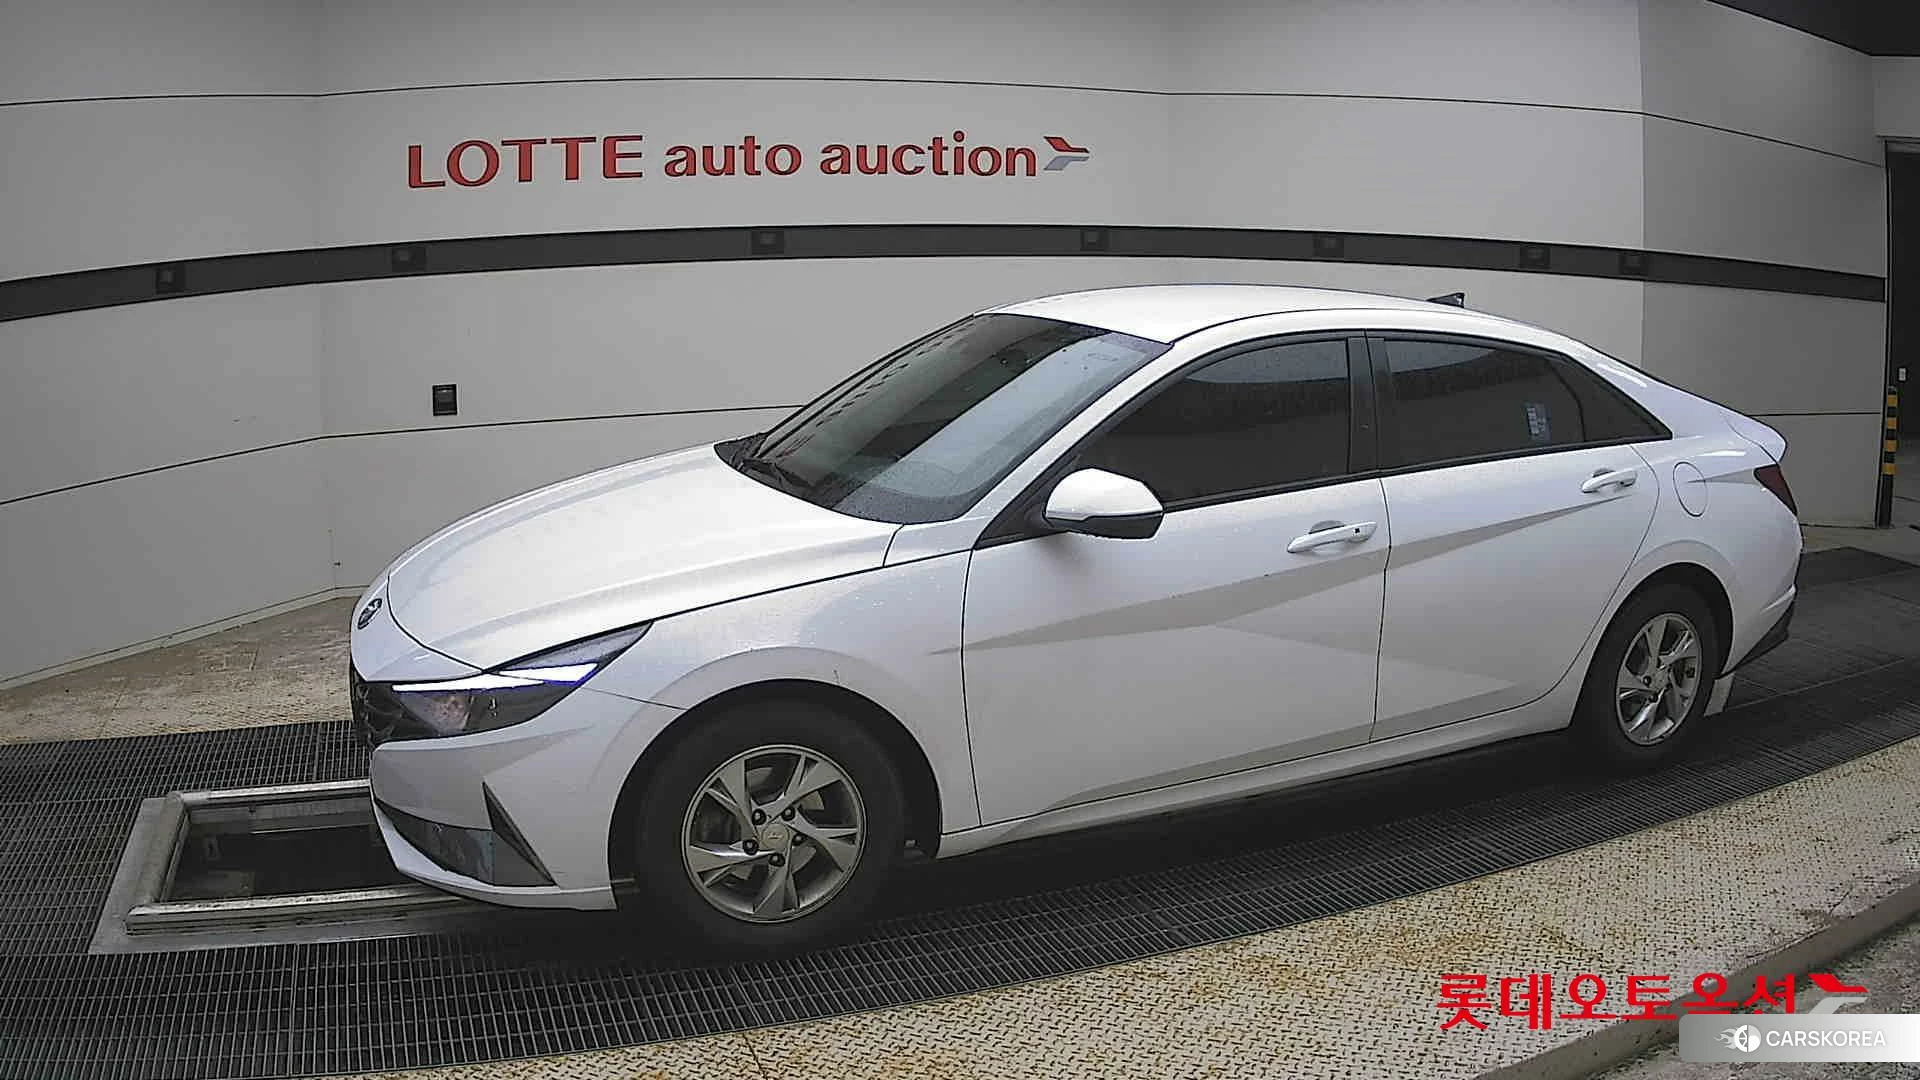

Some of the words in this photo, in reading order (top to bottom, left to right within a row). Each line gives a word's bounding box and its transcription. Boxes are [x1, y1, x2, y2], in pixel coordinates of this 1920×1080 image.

[408, 135, 643, 188] LOTTE
[664, 136, 802, 177] auto
[820, 131, 1037, 177] auction
